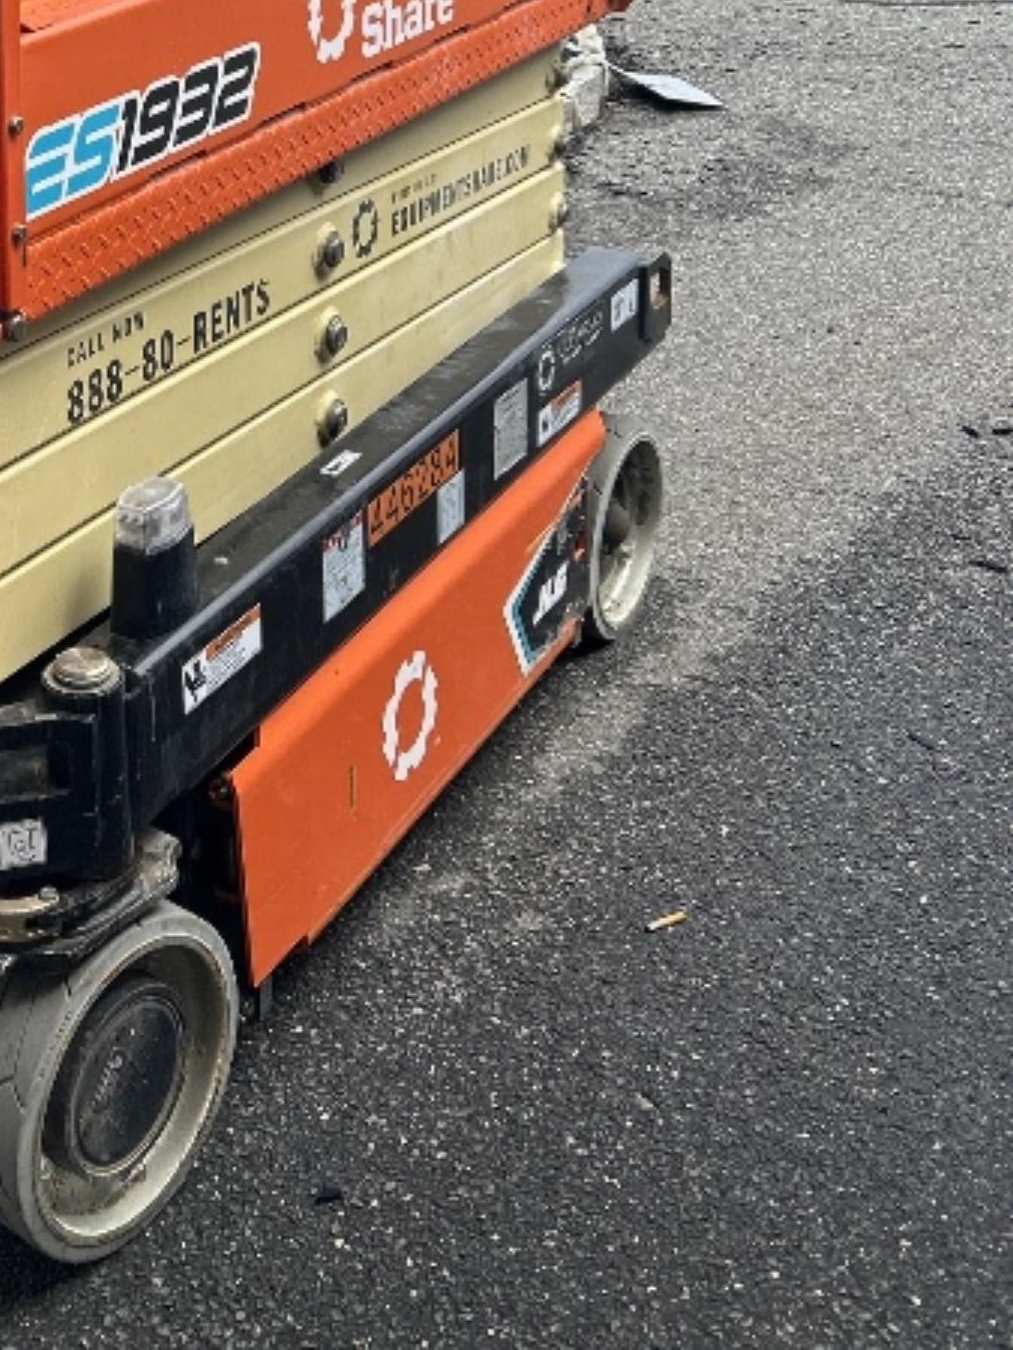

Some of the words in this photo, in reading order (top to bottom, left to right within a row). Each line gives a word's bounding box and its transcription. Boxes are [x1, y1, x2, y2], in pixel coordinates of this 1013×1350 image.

[25, 41, 261, 222] ES1932
[67, 332, 105, 368] CALL
[67, 278, 271, 426] 888-80-RENTS
